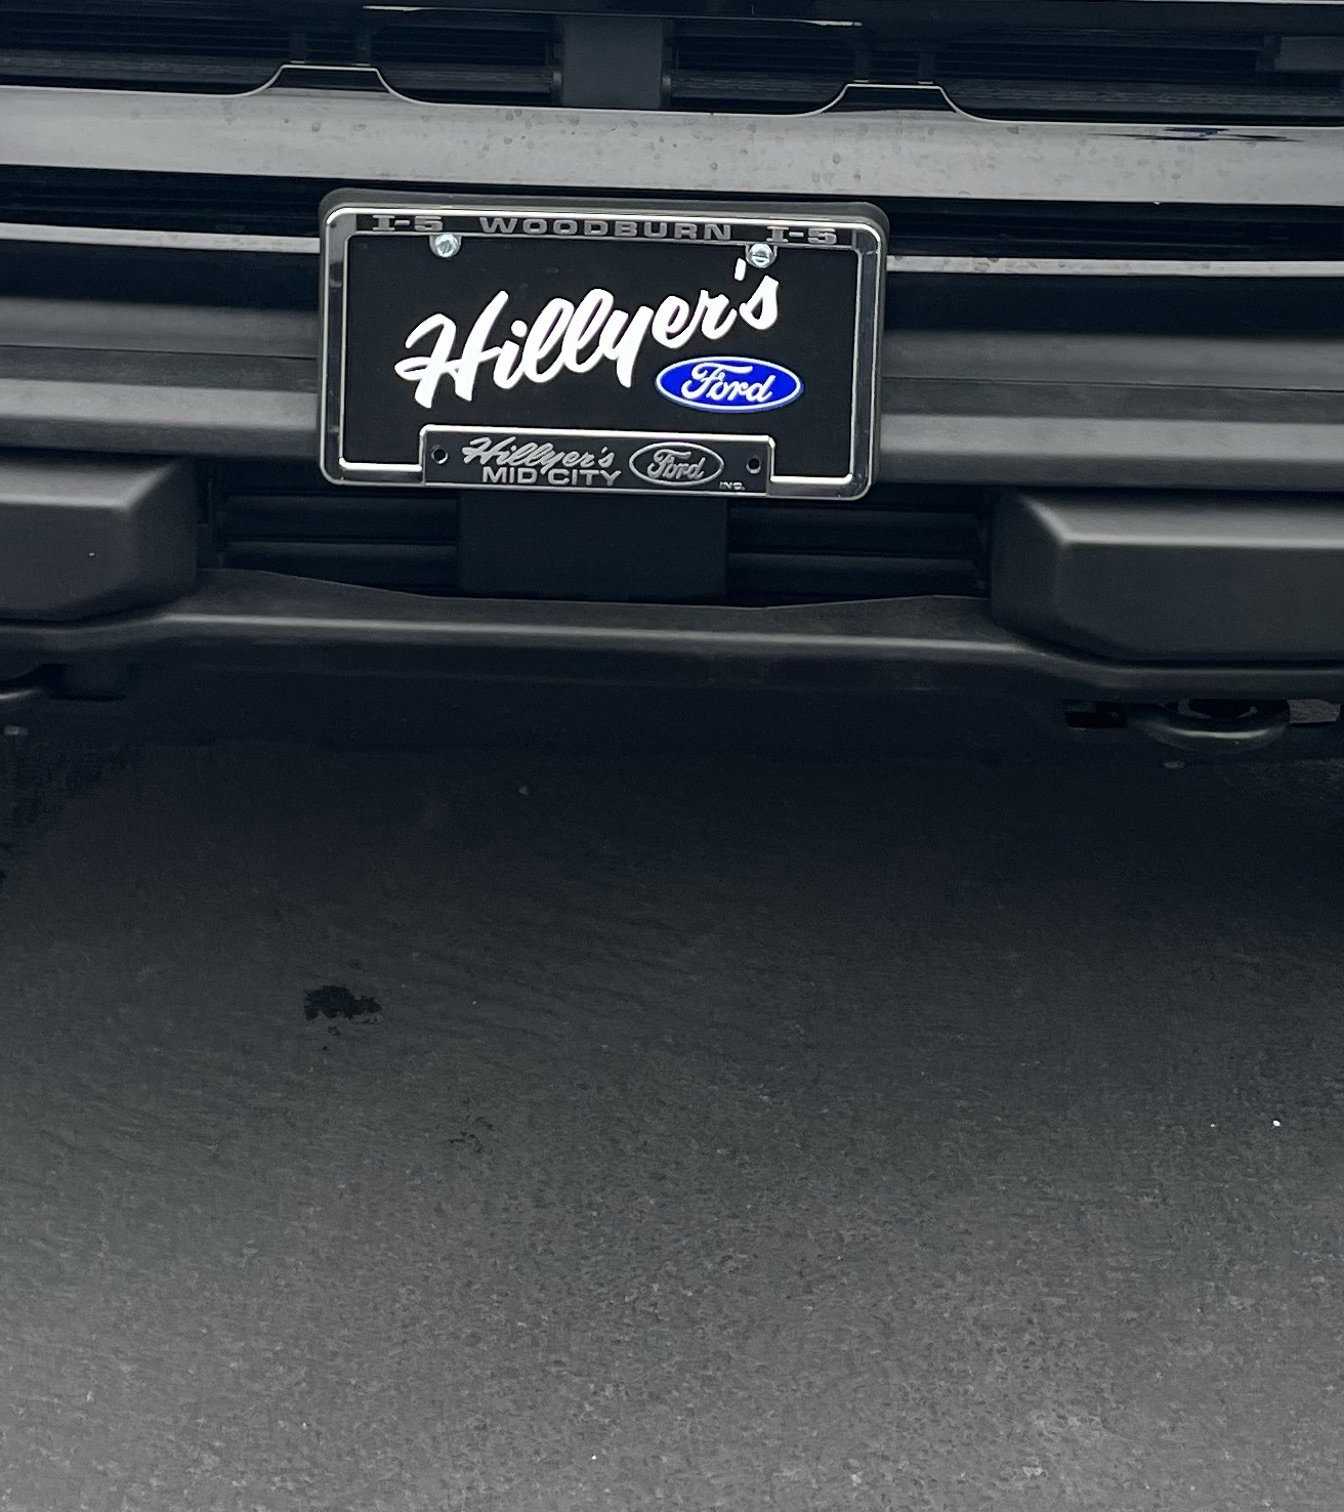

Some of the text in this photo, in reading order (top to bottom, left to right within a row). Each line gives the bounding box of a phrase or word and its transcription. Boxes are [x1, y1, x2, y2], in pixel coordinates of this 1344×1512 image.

[372, 214, 837, 245] I-5 WOODBURN I-5
[393, 258, 780, 409] Hillyer's
[681, 361, 777, 403] Ford
[461, 436, 707, 480] Hillyer's Ford
[482, 466, 538, 484] MID
[547, 467, 623, 487] CITY
